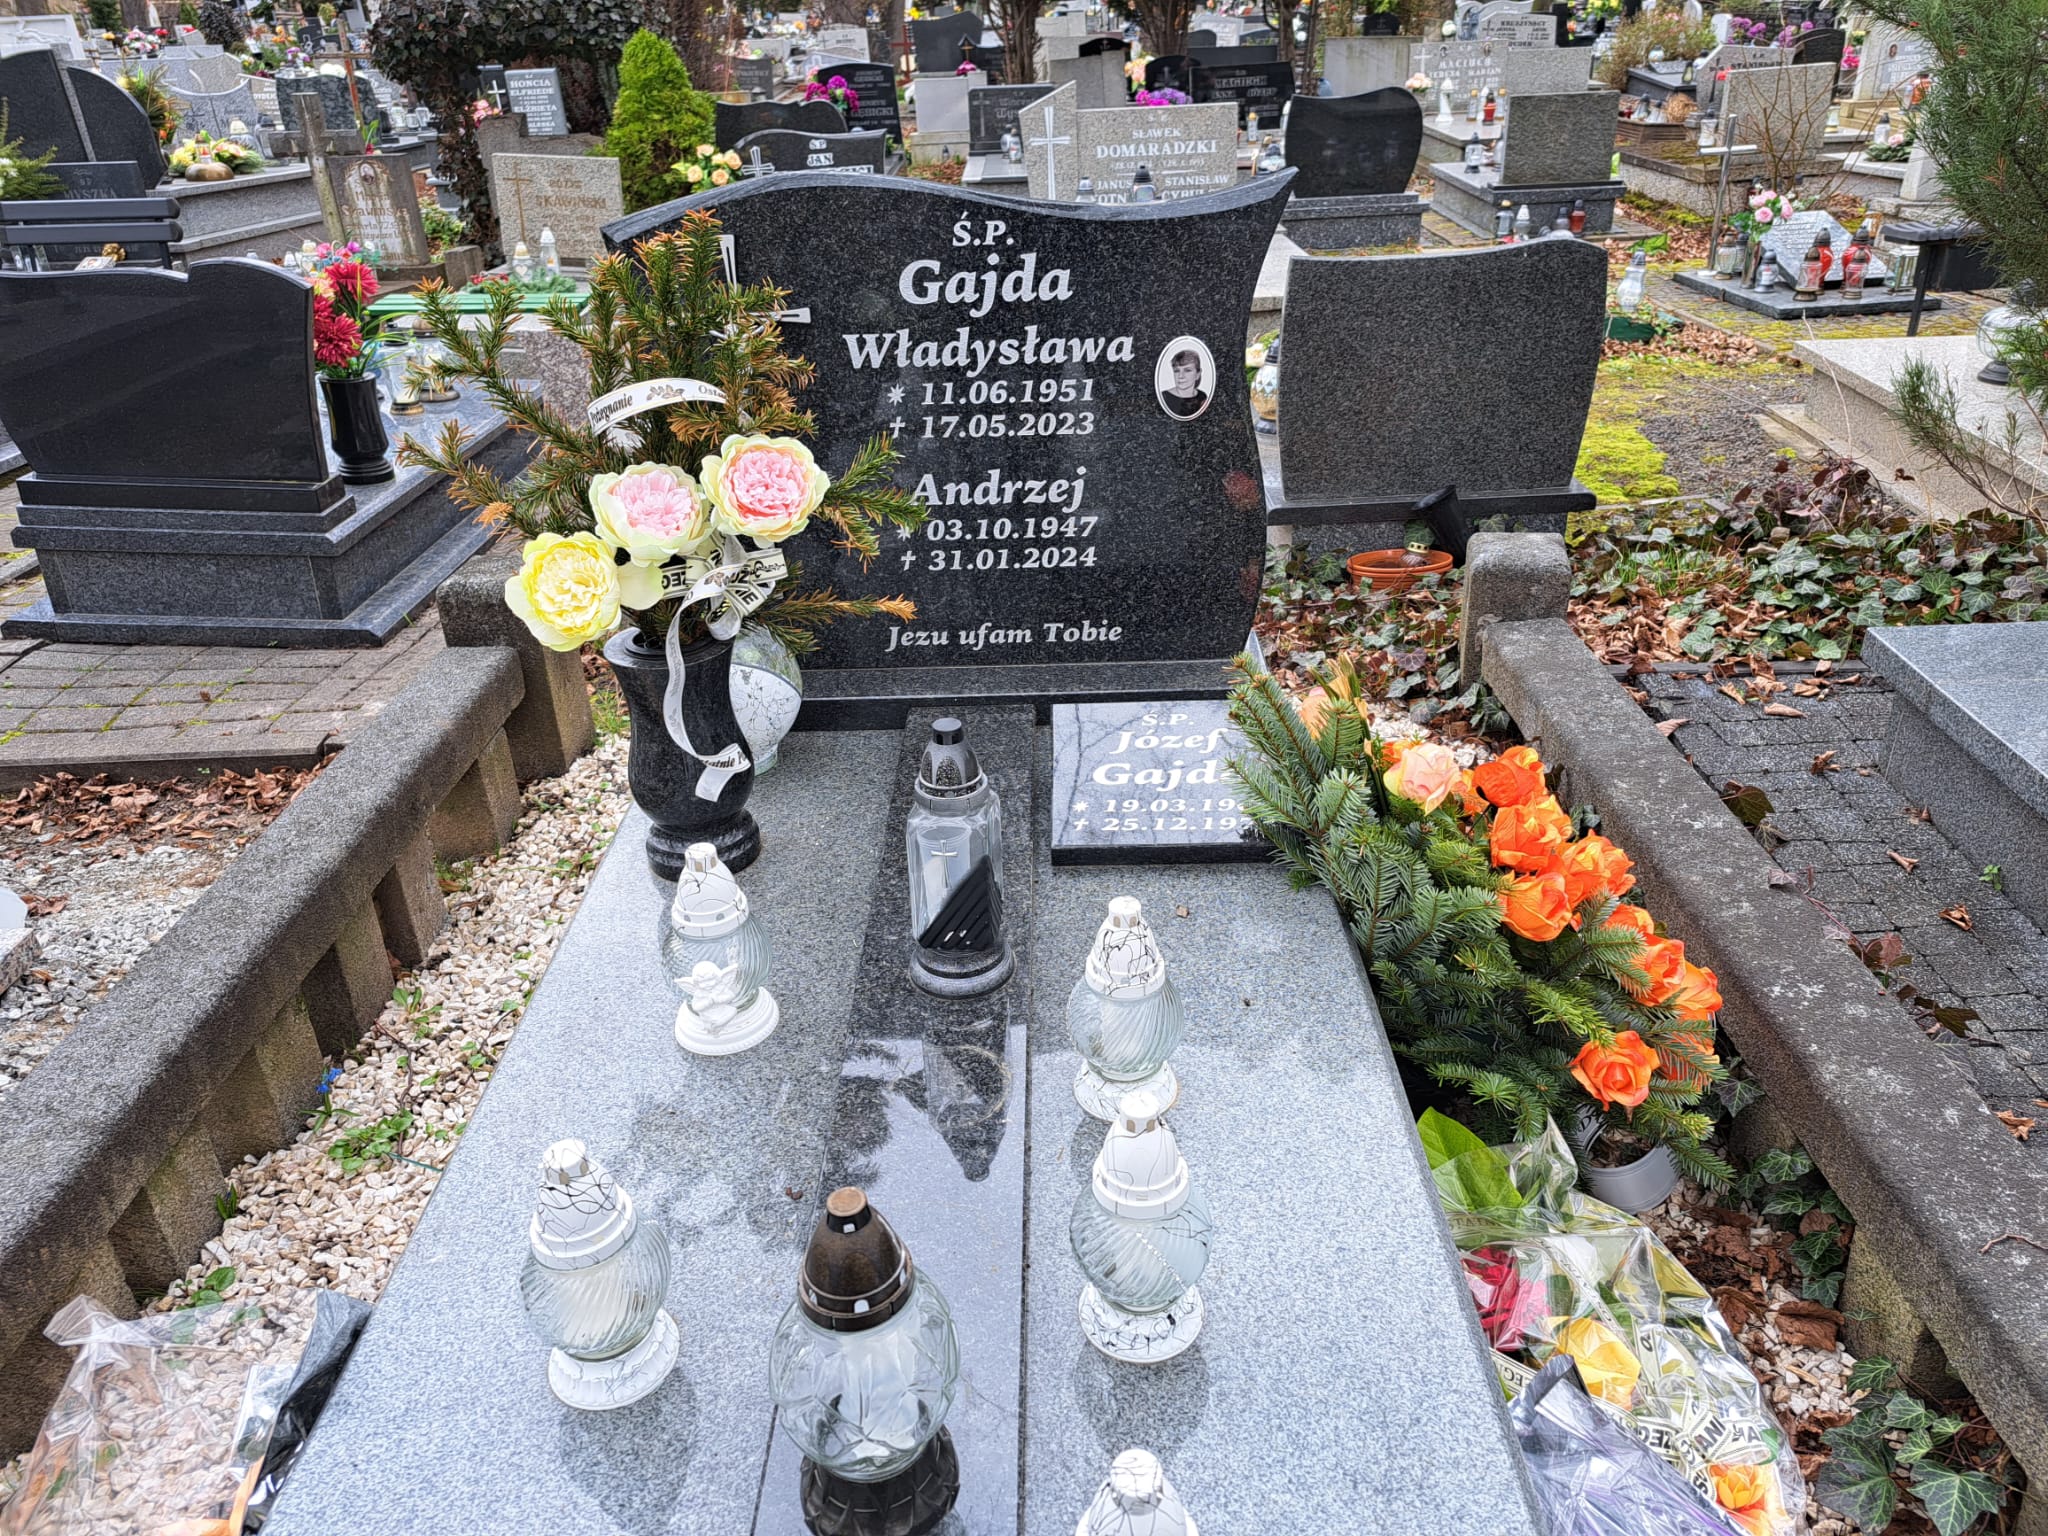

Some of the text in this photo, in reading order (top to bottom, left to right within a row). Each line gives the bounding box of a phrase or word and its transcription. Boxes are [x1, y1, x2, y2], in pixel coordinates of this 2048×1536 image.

[1132, 127, 1182, 140] SŁAWEK
[807, 153, 834, 166] JAN
[1096, 139, 1219, 159] DOMARADZKI
[1098, 174, 1231, 191] JANUS STANISŁAW
[952, 211, 1015, 247] Ś.P.
[899, 252, 1073, 318] Gajda
[842, 325, 1135, 378] Władysława
[921, 377, 1095, 406] 11.06.1951
[921, 411, 1095, 439] 17.05.2023
[911, 466, 1088, 514] Andrzej
[927, 515, 1099, 541] 03.10.1947
[928, 545, 1098, 571] 31.01.2024
[885, 619, 1124, 652] Jezu ufam Tobie
[1109, 727, 1229, 755] Józef
[1103, 799, 1246, 813] 19.03.19
